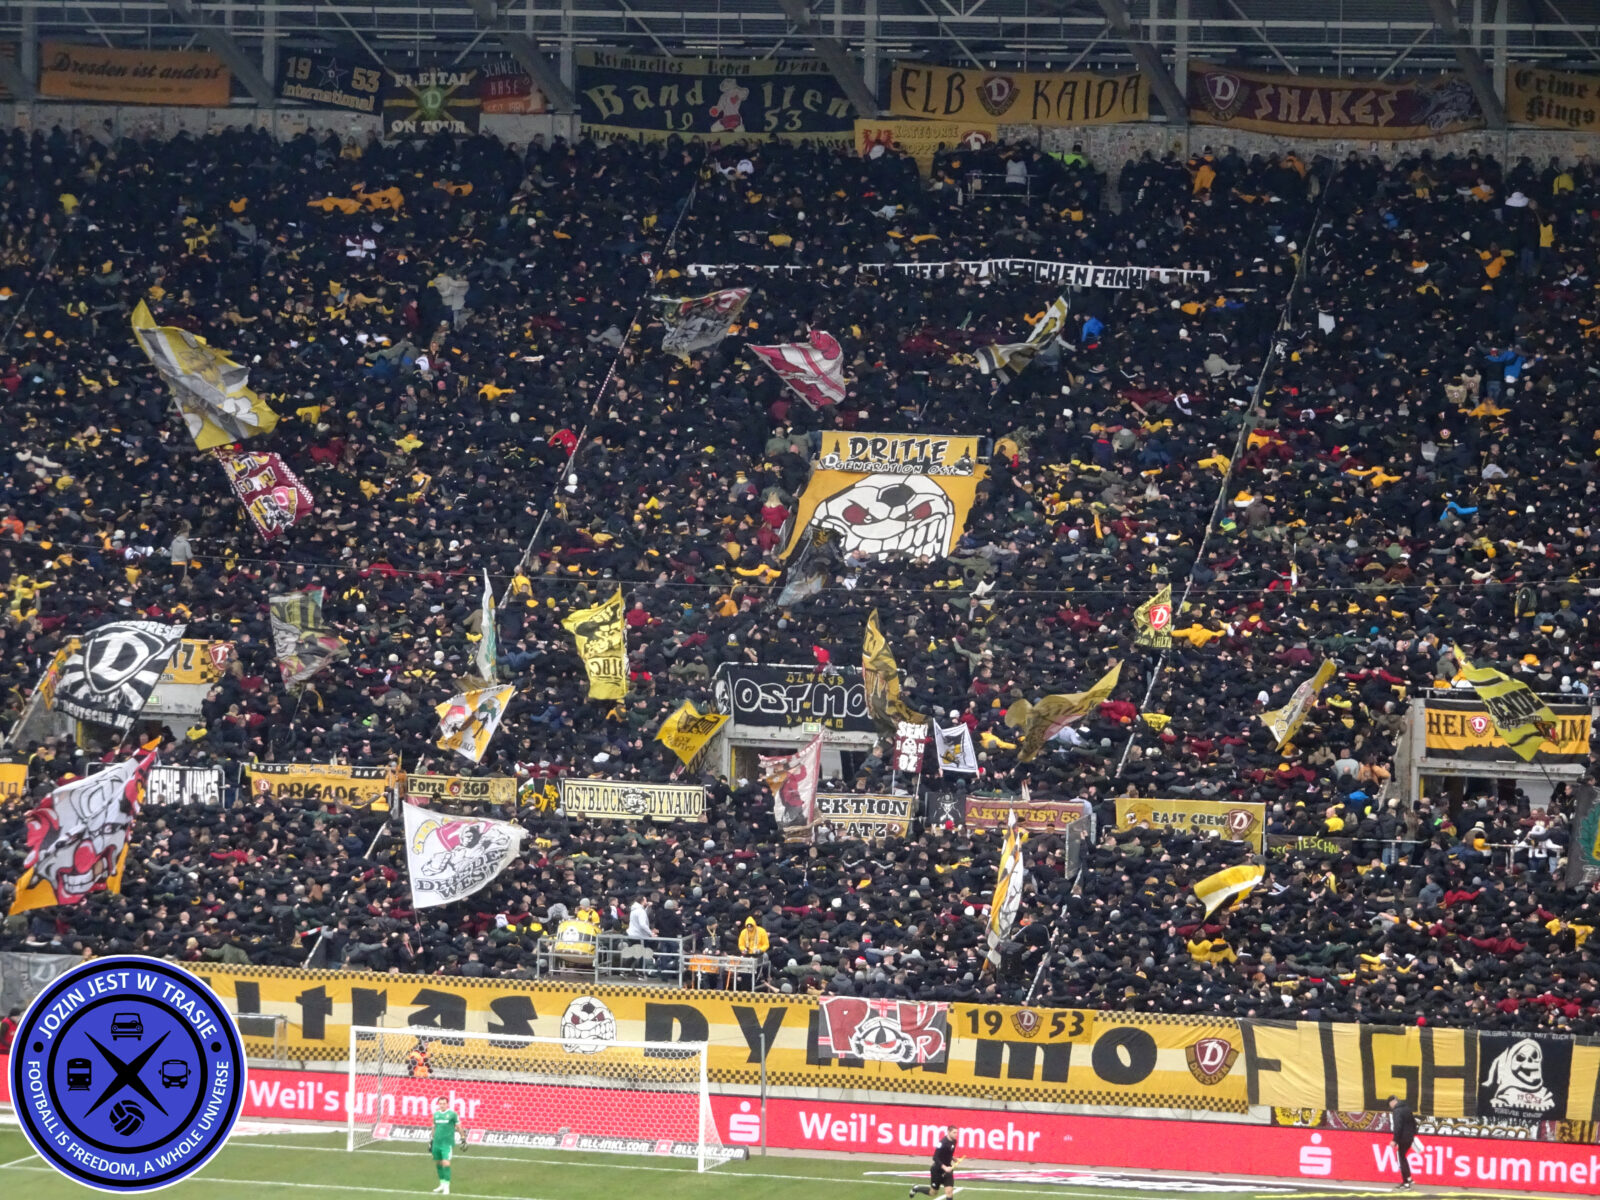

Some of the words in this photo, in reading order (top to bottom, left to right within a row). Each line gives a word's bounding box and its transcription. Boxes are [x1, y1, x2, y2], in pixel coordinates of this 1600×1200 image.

[42, 52, 127, 78] Dresden
[132, 62, 157, 78] ist
[287, 57, 311, 80] 19
[352, 67, 381, 93] 53
[900, 68, 966, 115] ELB
[1032, 73, 1142, 121] KAIDA
[1254, 84, 1398, 127] SNAKES
[391, 119, 416, 134] ON
[421, 119, 467, 134] TOUR
[664, 110, 693, 131] 19
[764, 110, 803, 132] 53
[848, 435, 949, 464] DRITTE
[408, 778, 446, 794] Forza
[565, 785, 625, 813] OSTBLOCK
[649, 790, 702, 816] DYNAMO
[1152, 811, 1187, 825] EAST
[1190, 812, 1230, 827] CREW
[965, 1008, 1003, 1036] 19
[1048, 1010, 1085, 1039] 53
[249, 1079, 340, 1113] Weil's
[345, 1091, 396, 1117] um
[402, 1089, 482, 1119] mehr
[799, 1110, 895, 1143] Weil's
[898, 1123, 950, 1148] um
[956, 1121, 1041, 1153] mehr
[1372, 1142, 1472, 1178] Weil's
[1476, 1153, 1533, 1182] um
